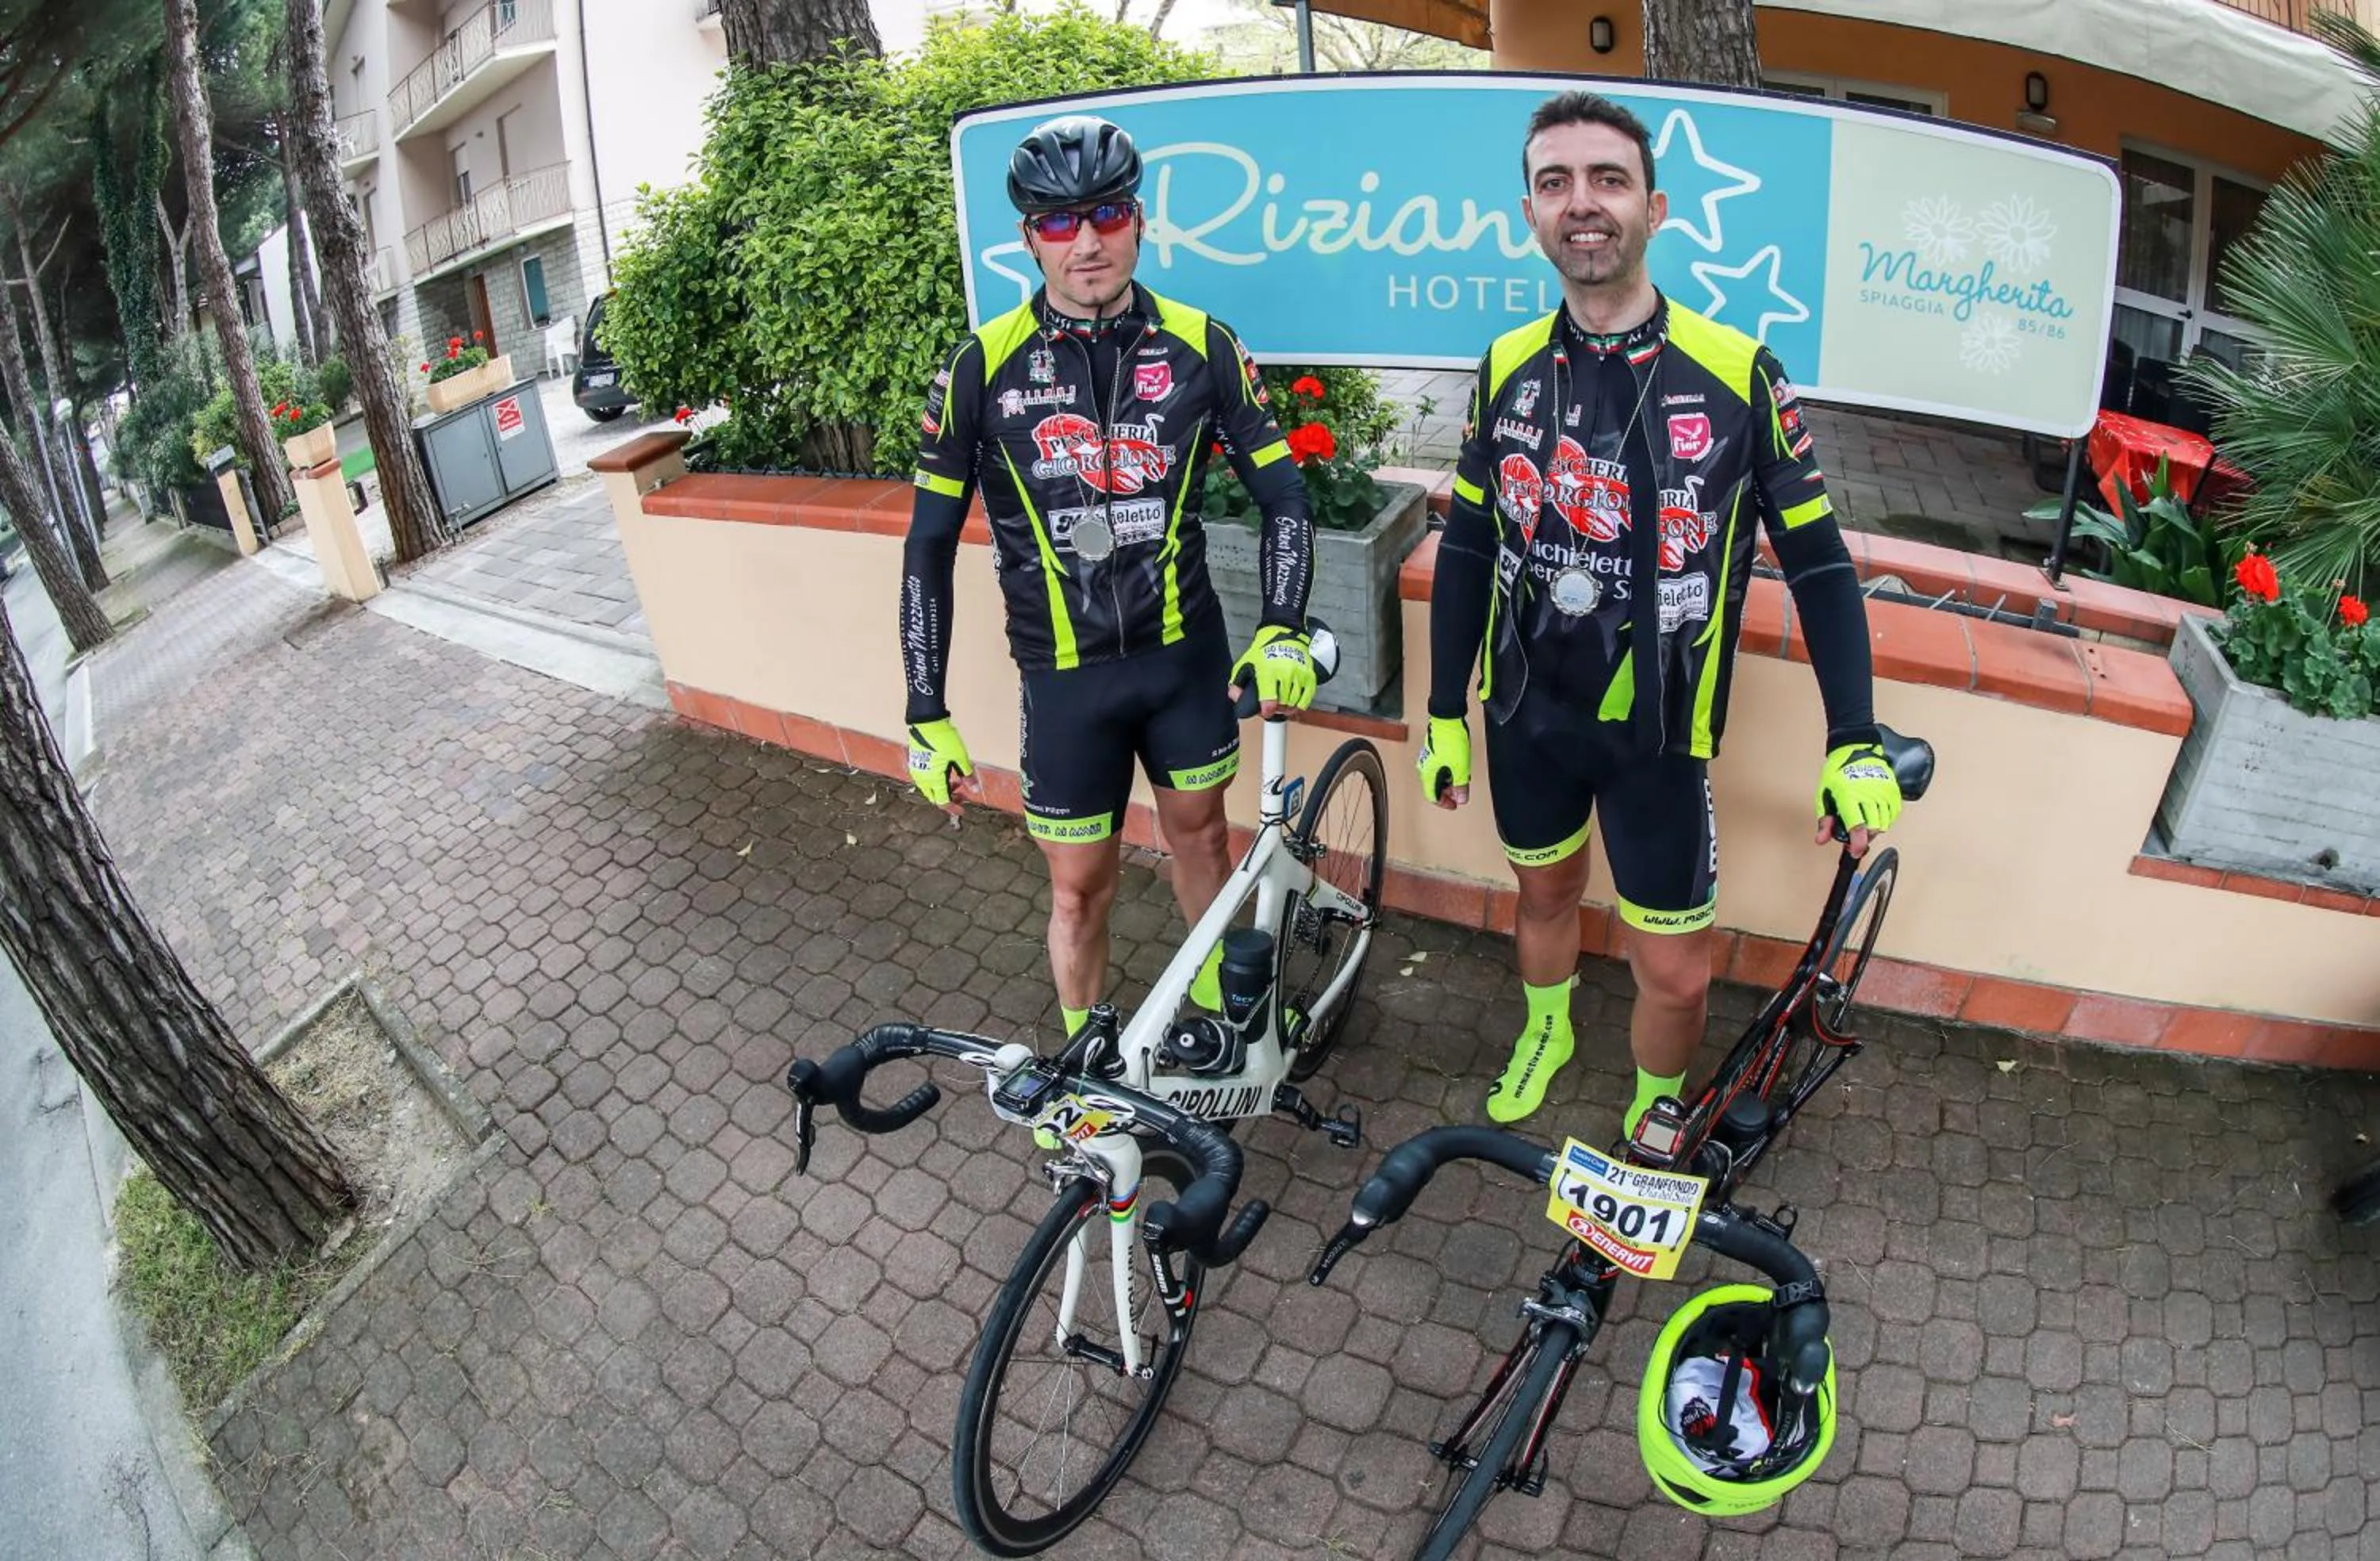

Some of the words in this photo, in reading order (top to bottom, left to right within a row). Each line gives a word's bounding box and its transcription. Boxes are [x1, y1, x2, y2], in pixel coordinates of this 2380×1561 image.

[1140, 141, 1549, 269] Rizian
[1388, 274, 1558, 313] HOTEL
[1858, 241, 2074, 322] Margherita
[1860, 289, 1945, 316] SPIAGGIA
[2017, 318, 2066, 339] 85/86
[1532, 539, 1633, 577] ichielett
[1168, 1084, 1263, 1119] CIPOLLINI
[1632, 1173, 1699, 1196] GRANFONDO
[1568, 1183, 1672, 1243] 1901
